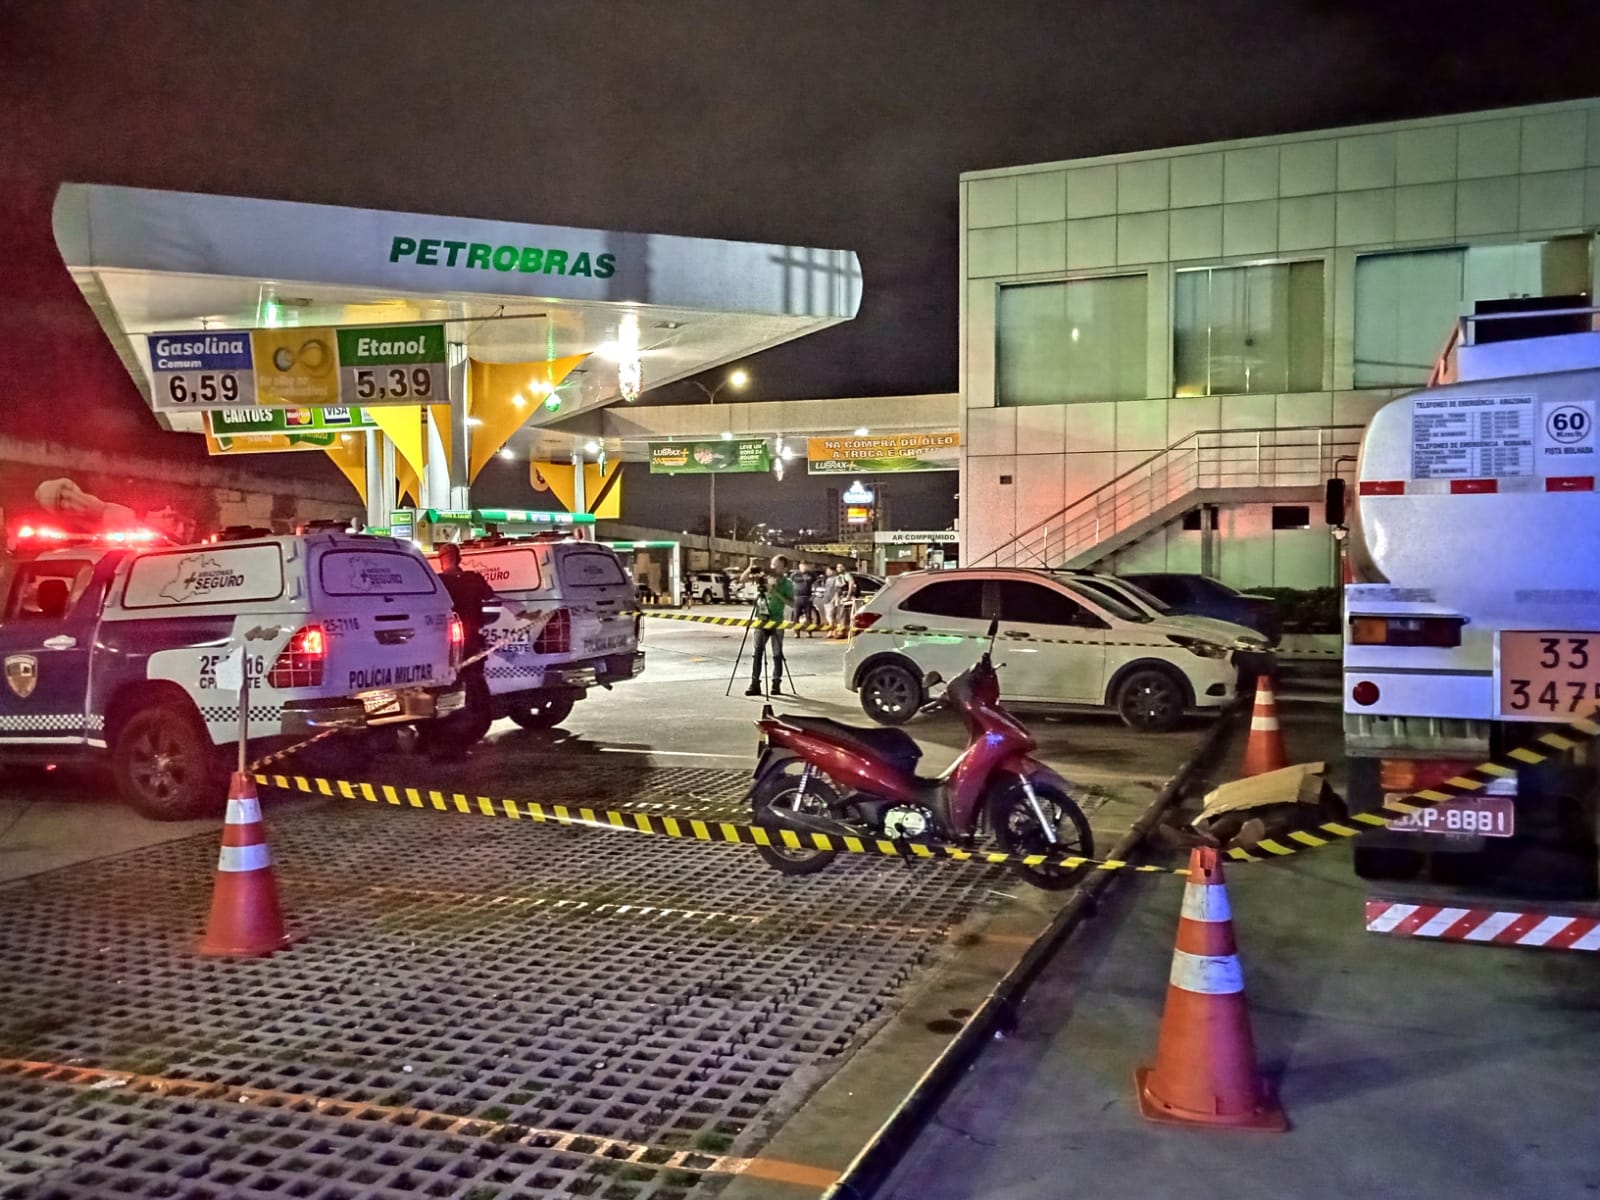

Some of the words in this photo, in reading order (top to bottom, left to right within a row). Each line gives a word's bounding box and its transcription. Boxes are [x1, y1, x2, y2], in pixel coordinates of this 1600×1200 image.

[389, 236, 616, 279] PETROBRAS
[156, 337, 244, 357] Gasolina
[357, 336, 426, 357] Etanol
[158, 359, 202, 369] Comum
[169, 374, 239, 403] 6,59
[357, 368, 432, 398] 5,39
[1553, 412, 1585, 431] 60
[825, 441, 840, 449] NA
[845, 440, 897, 448] COMPRA
[845, 449, 883, 458] TROCA
[905, 533, 956, 541] COMPRIMIDO
[198, 569, 234, 577] AMAZONAS
[367, 574, 403, 585] SEGURO
[483, 570, 511, 581] GURO
[195, 575, 245, 590] SEGURO
[323, 617, 360, 632] 25-7116
[1540, 638, 1589, 670] 33
[394, 663, 433, 684] MILITAR
